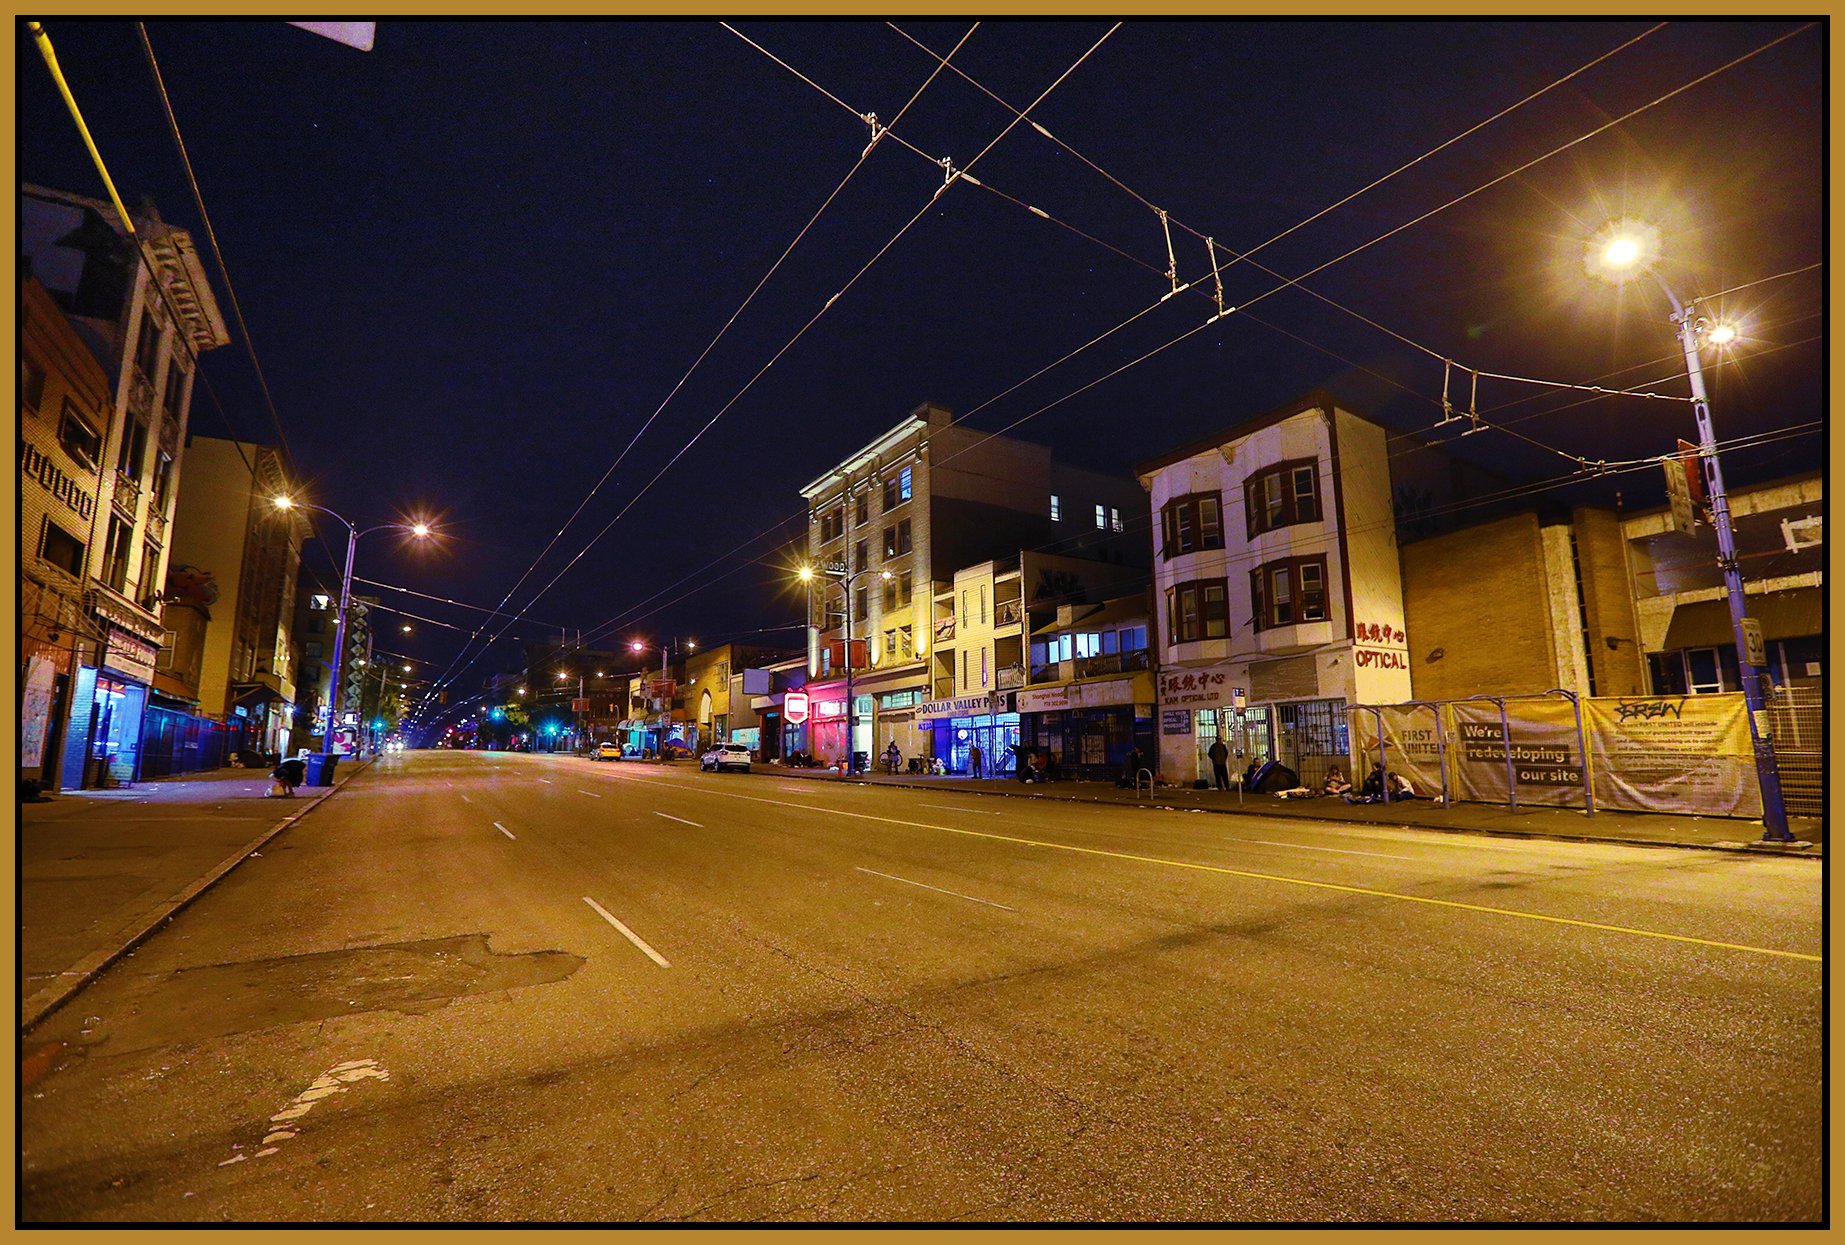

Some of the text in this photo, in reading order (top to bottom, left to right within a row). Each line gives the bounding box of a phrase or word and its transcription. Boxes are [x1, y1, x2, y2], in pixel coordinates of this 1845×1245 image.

[1748, 632, 1763, 653] 30
[1356, 650, 1407, 669] OPTICAL
[922, 695, 1005, 714] DOLLAR VALLEY PS
[1165, 692, 1219, 705] KAM OPTICAL LTD
[1401, 730, 1432, 741] FIRST
[1463, 725, 1502, 738] We're
[1403, 743, 1446, 754] UNITED
[1469, 746, 1565, 763] redeveloping
[1520, 769, 1579, 782] our site
